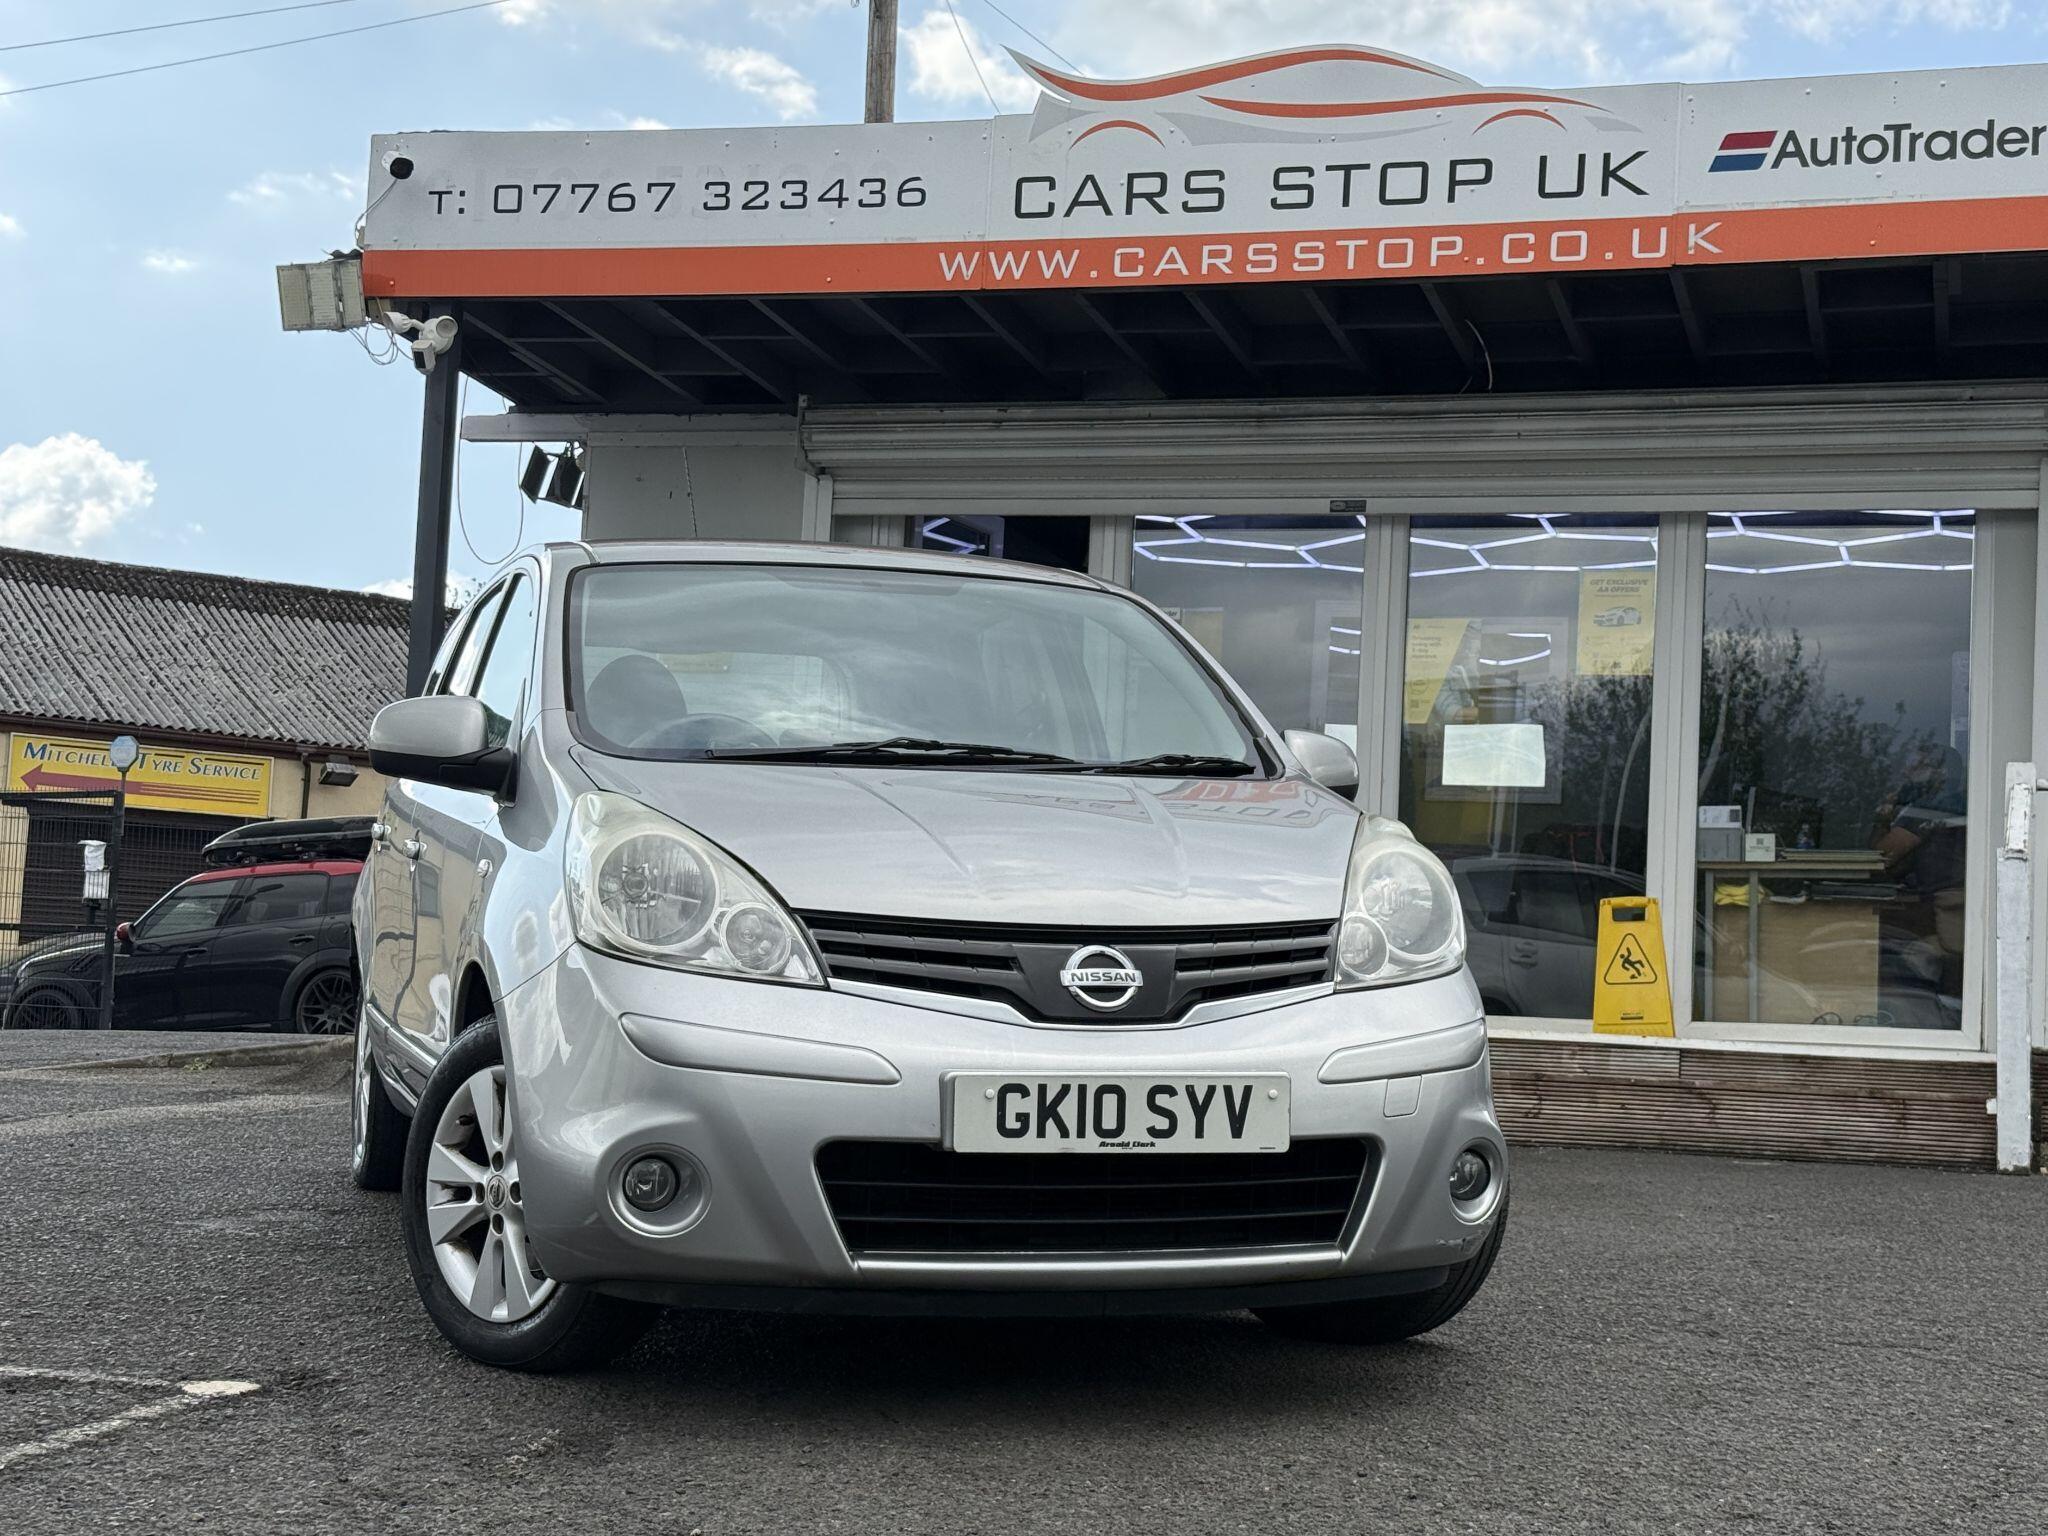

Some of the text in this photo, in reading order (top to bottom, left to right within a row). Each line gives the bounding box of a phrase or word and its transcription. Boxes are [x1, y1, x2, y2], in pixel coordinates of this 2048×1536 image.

[1771, 119, 2048, 169] AutoTrader
[428, 176, 927, 215] T: 07767 323436
[1014, 150, 1650, 219] CARS STOP UK
[939, 221, 1723, 282] WWW.CARSSTOP.CO.UK
[187, 756, 261, 780] SERVICE
[1070, 972, 1137, 984] NISSAN
[996, 1082, 1254, 1139] GK10 SYV
